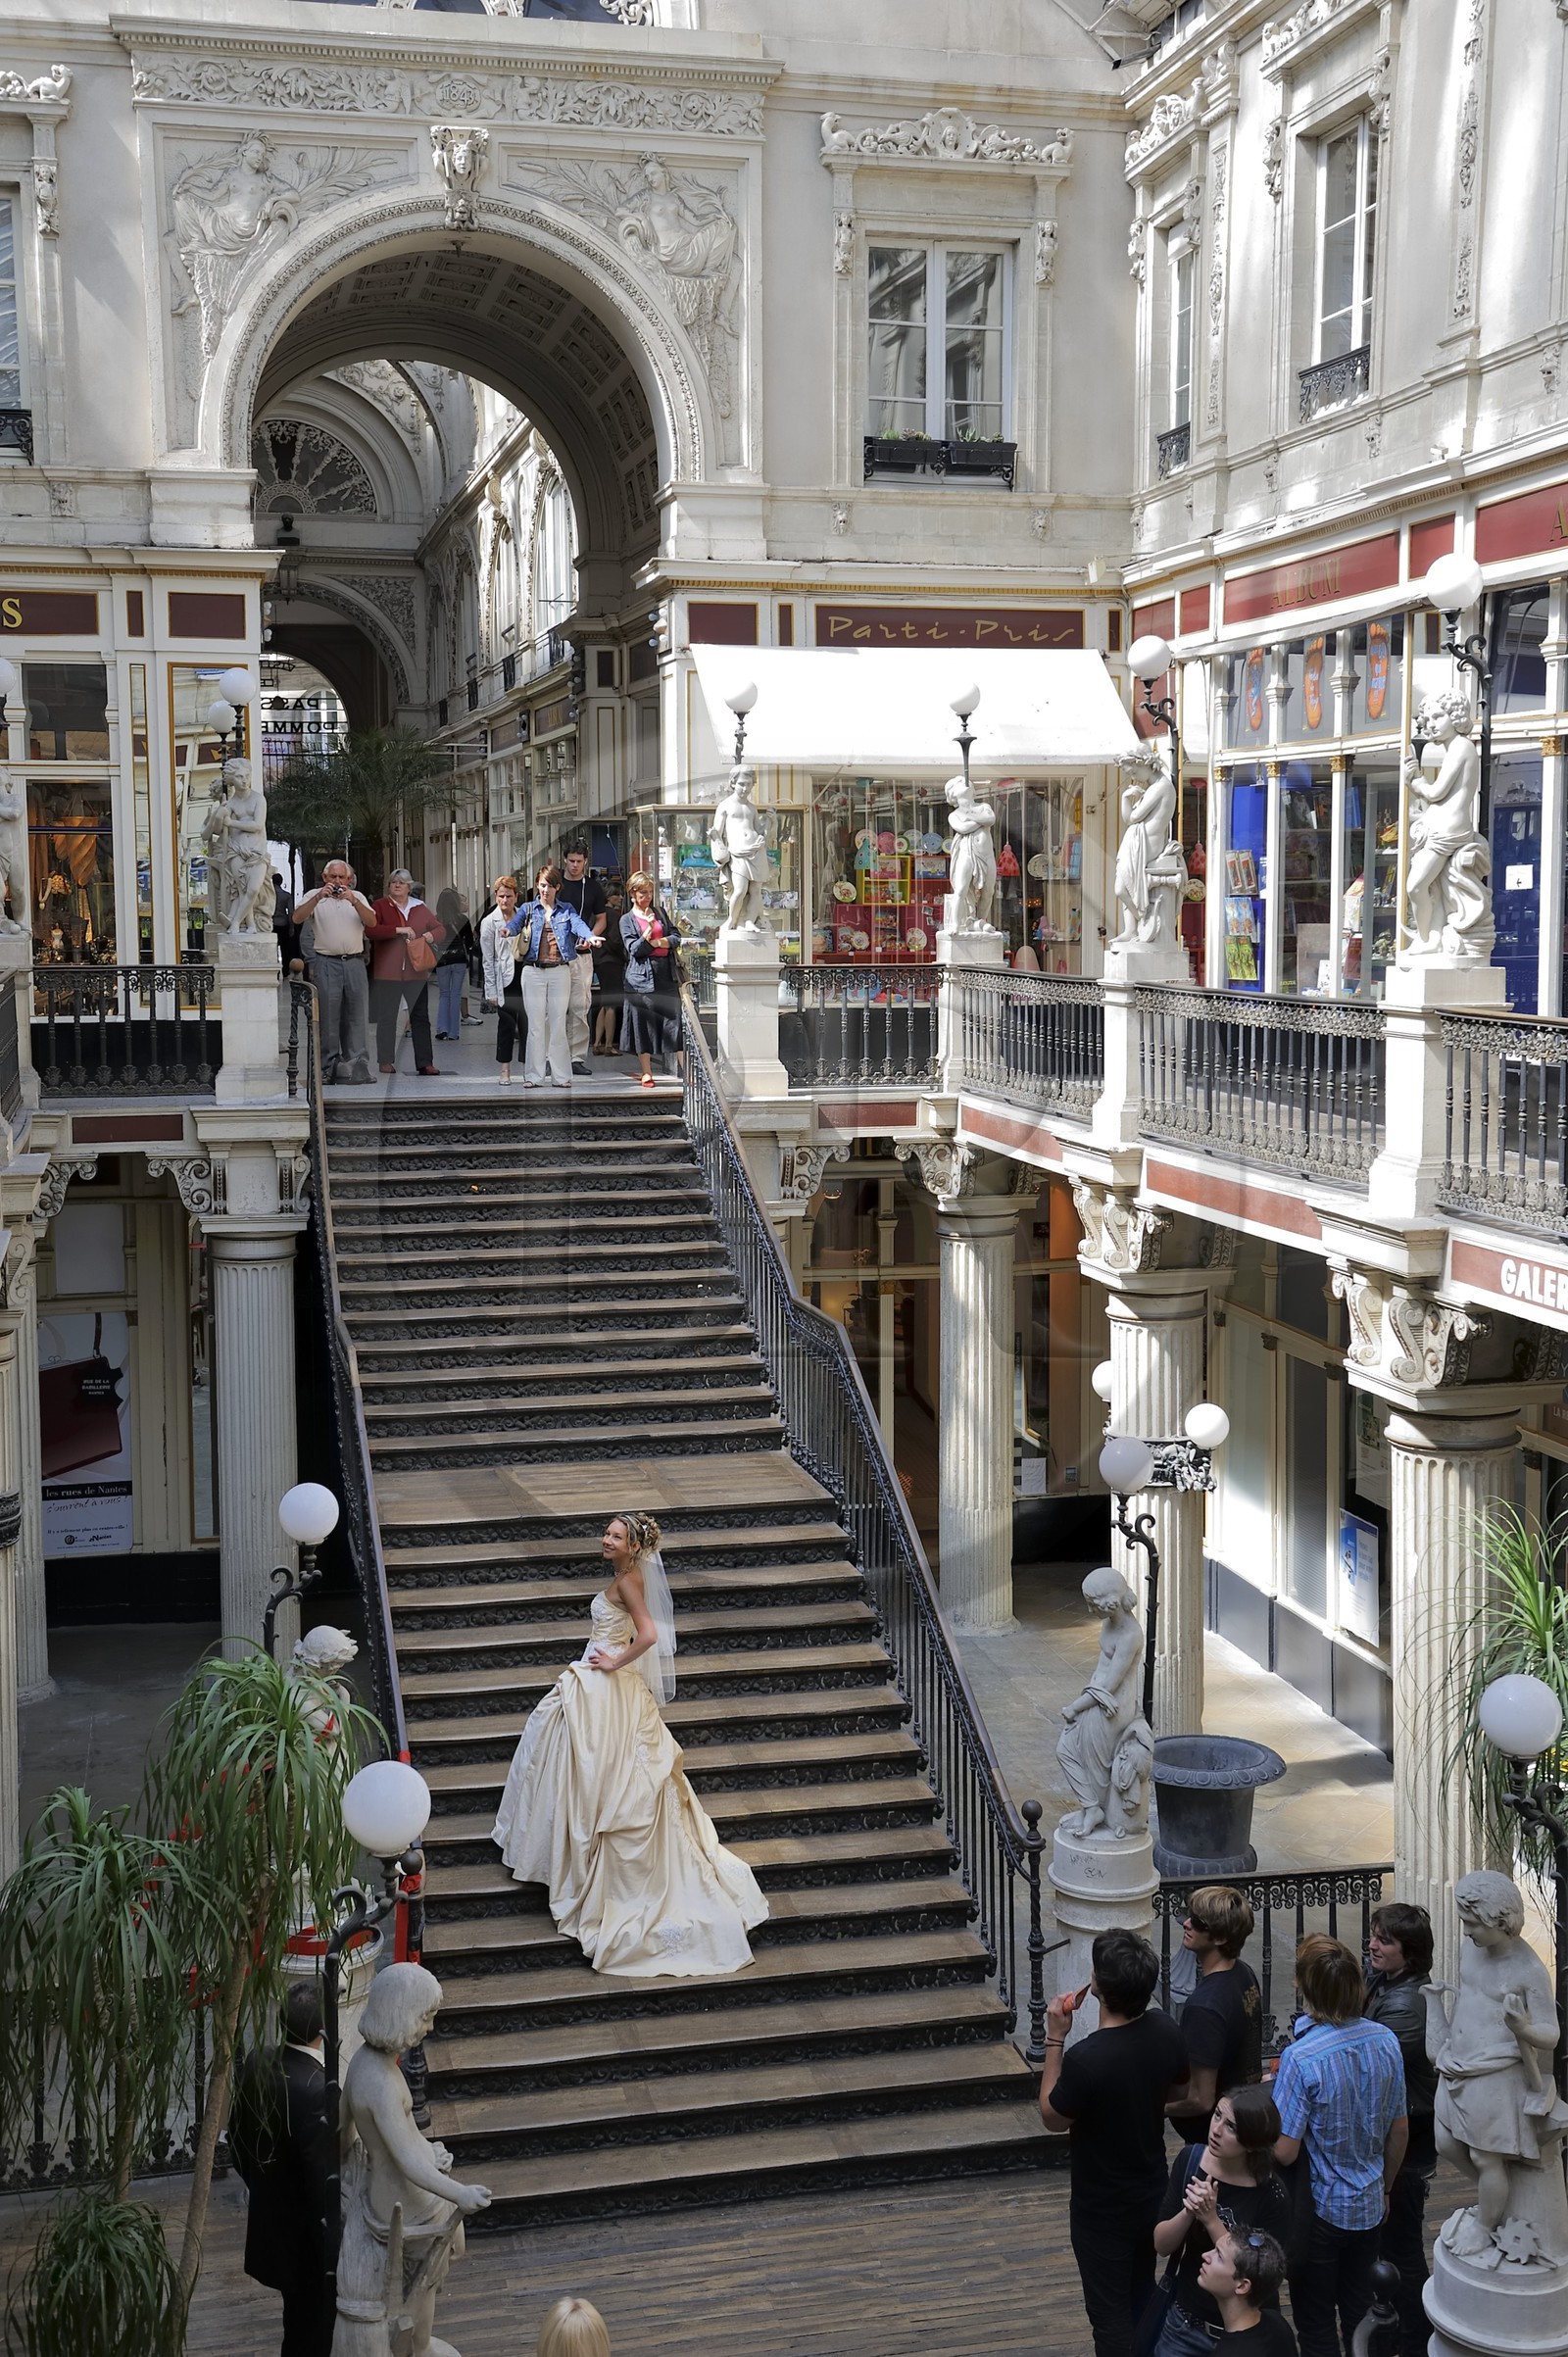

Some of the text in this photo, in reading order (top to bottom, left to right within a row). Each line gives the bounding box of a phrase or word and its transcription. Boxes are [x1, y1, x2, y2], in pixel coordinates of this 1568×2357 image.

[444, 84, 473, 106] 1843
[1, 597, 23, 628] S
[46, 1488, 59, 1498] les
[84, 1486, 96, 1495] de
[98, 1485, 127, 1494] Nantes
